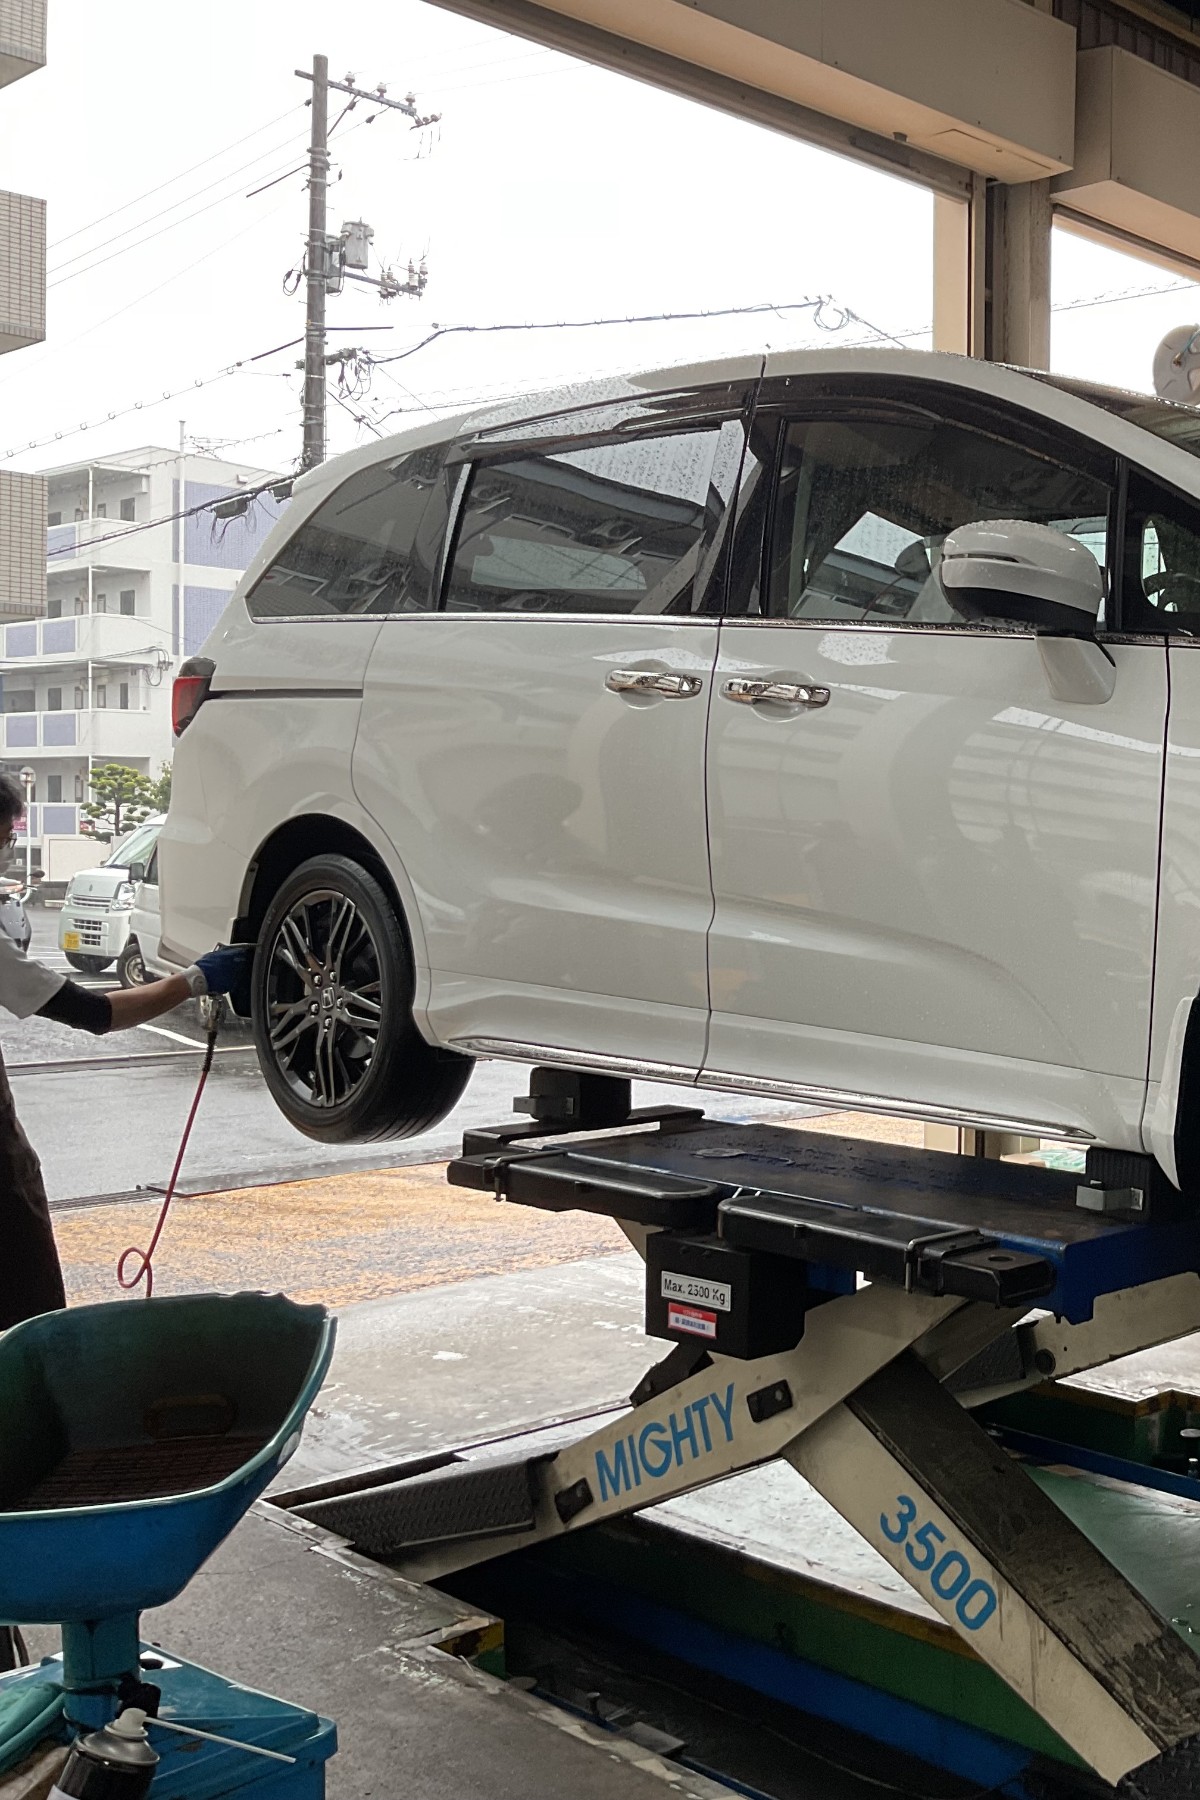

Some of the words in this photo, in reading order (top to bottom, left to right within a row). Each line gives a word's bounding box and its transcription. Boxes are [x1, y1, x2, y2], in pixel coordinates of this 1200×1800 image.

[664, 1278, 686, 1294] Max.
[712, 1288, 726, 1306] Kg
[595, 1382, 735, 1503] MIGHTY
[879, 1495, 997, 1631] 3500
